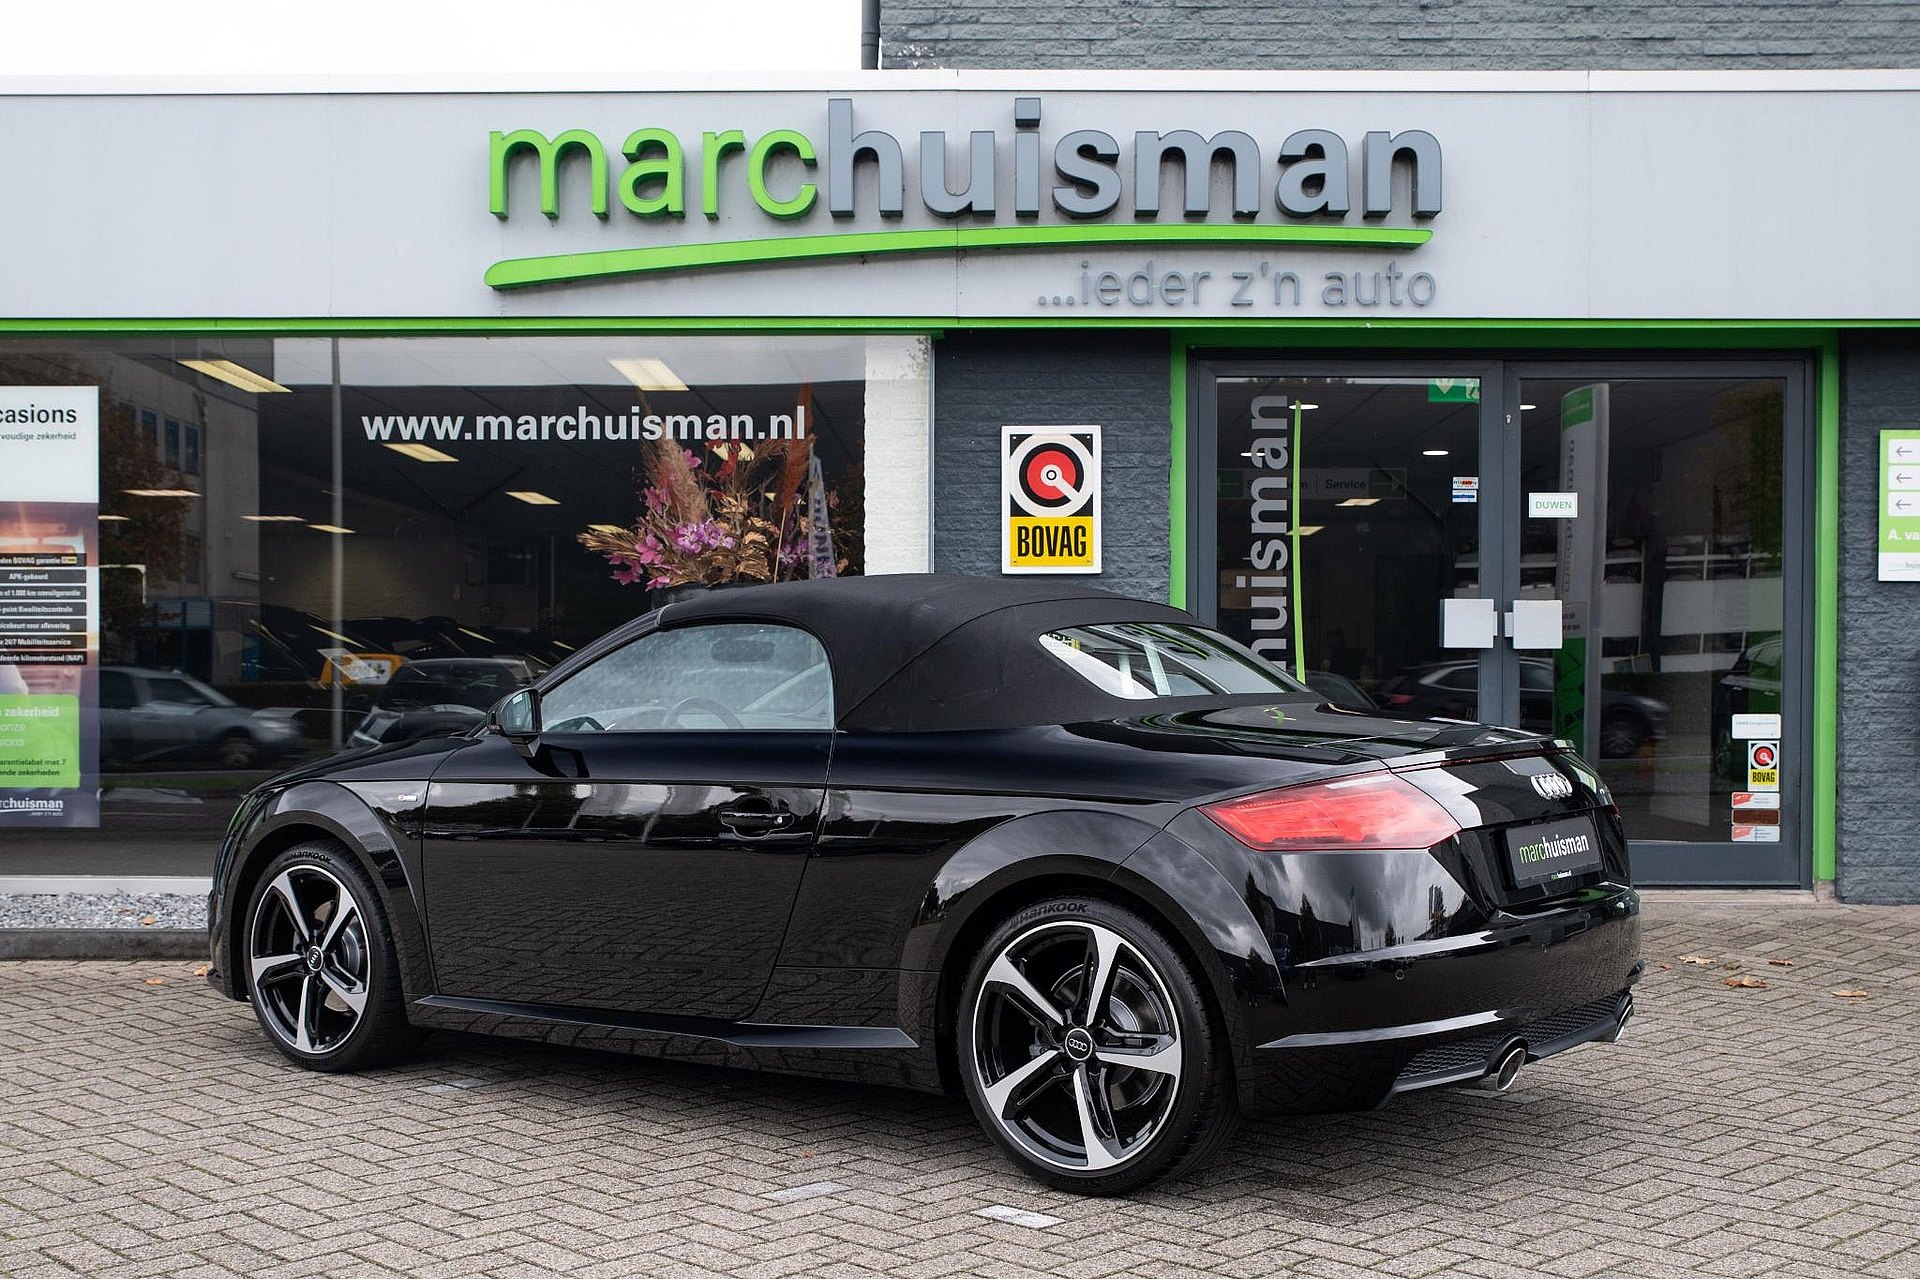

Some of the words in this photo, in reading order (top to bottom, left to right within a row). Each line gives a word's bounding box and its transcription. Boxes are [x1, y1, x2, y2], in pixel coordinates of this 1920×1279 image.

[489, 97, 1443, 222] marchuisman
[1230, 260, 1301, 306] z'n
[1321, 259, 1437, 308] auto
[361, 405, 806, 441] www.marchuisman.nl
[36, 431, 76, 440] zekerheid
[1325, 479, 1366, 490] Service
[1535, 500, 1573, 510] DUWEN
[1017, 525, 1087, 557] BOVAG
[1888, 529, 1902, 541] A.
[13, 557, 35, 565] BOVAG
[20, 654, 65, 662] kilometerstand
[5, 706, 60, 717] zekerheid
[1752, 771, 1776, 783] BOVAG
[1520, 834, 1590, 864] marchuisman
